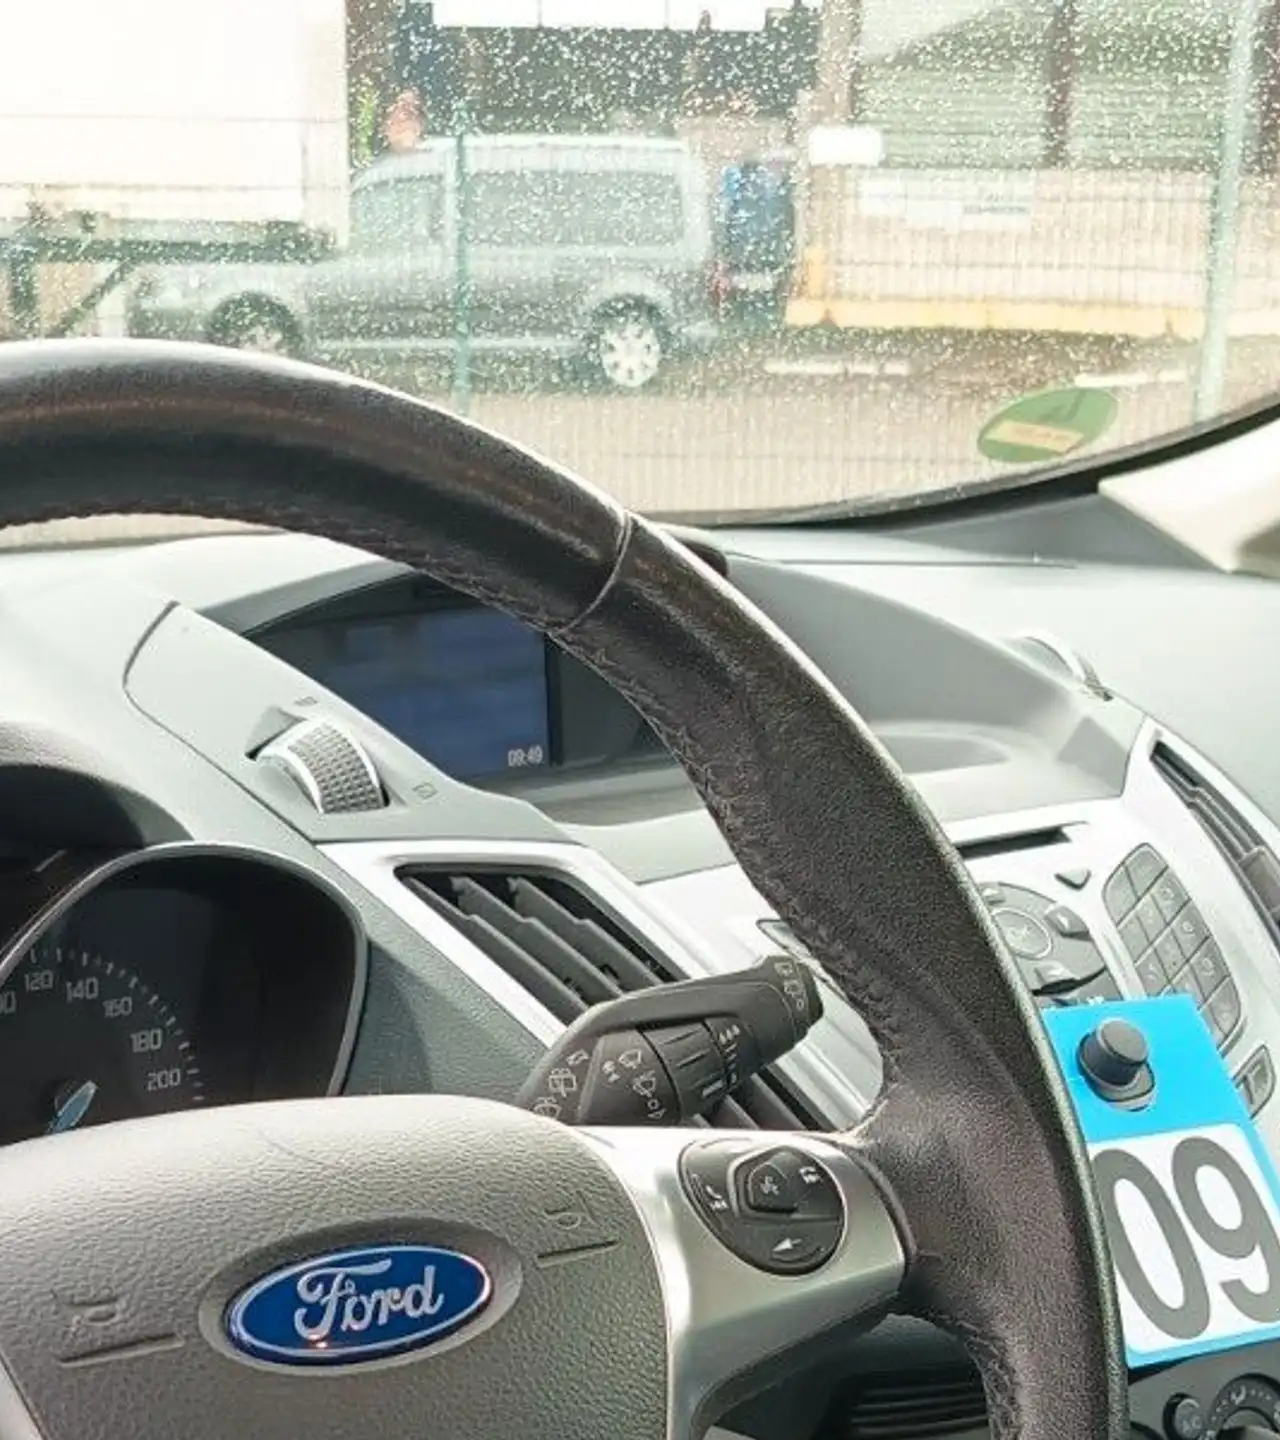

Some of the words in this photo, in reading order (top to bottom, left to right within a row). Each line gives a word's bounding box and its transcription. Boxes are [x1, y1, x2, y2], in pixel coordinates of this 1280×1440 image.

[23, 969, 54, 992] 120
[66, 976, 99, 1002] 140
[102, 996, 133, 1018] 160
[130, 1028, 162, 1054] 180
[147, 1067, 181, 1092] 200
[293, 1256, 445, 1341] Ford
